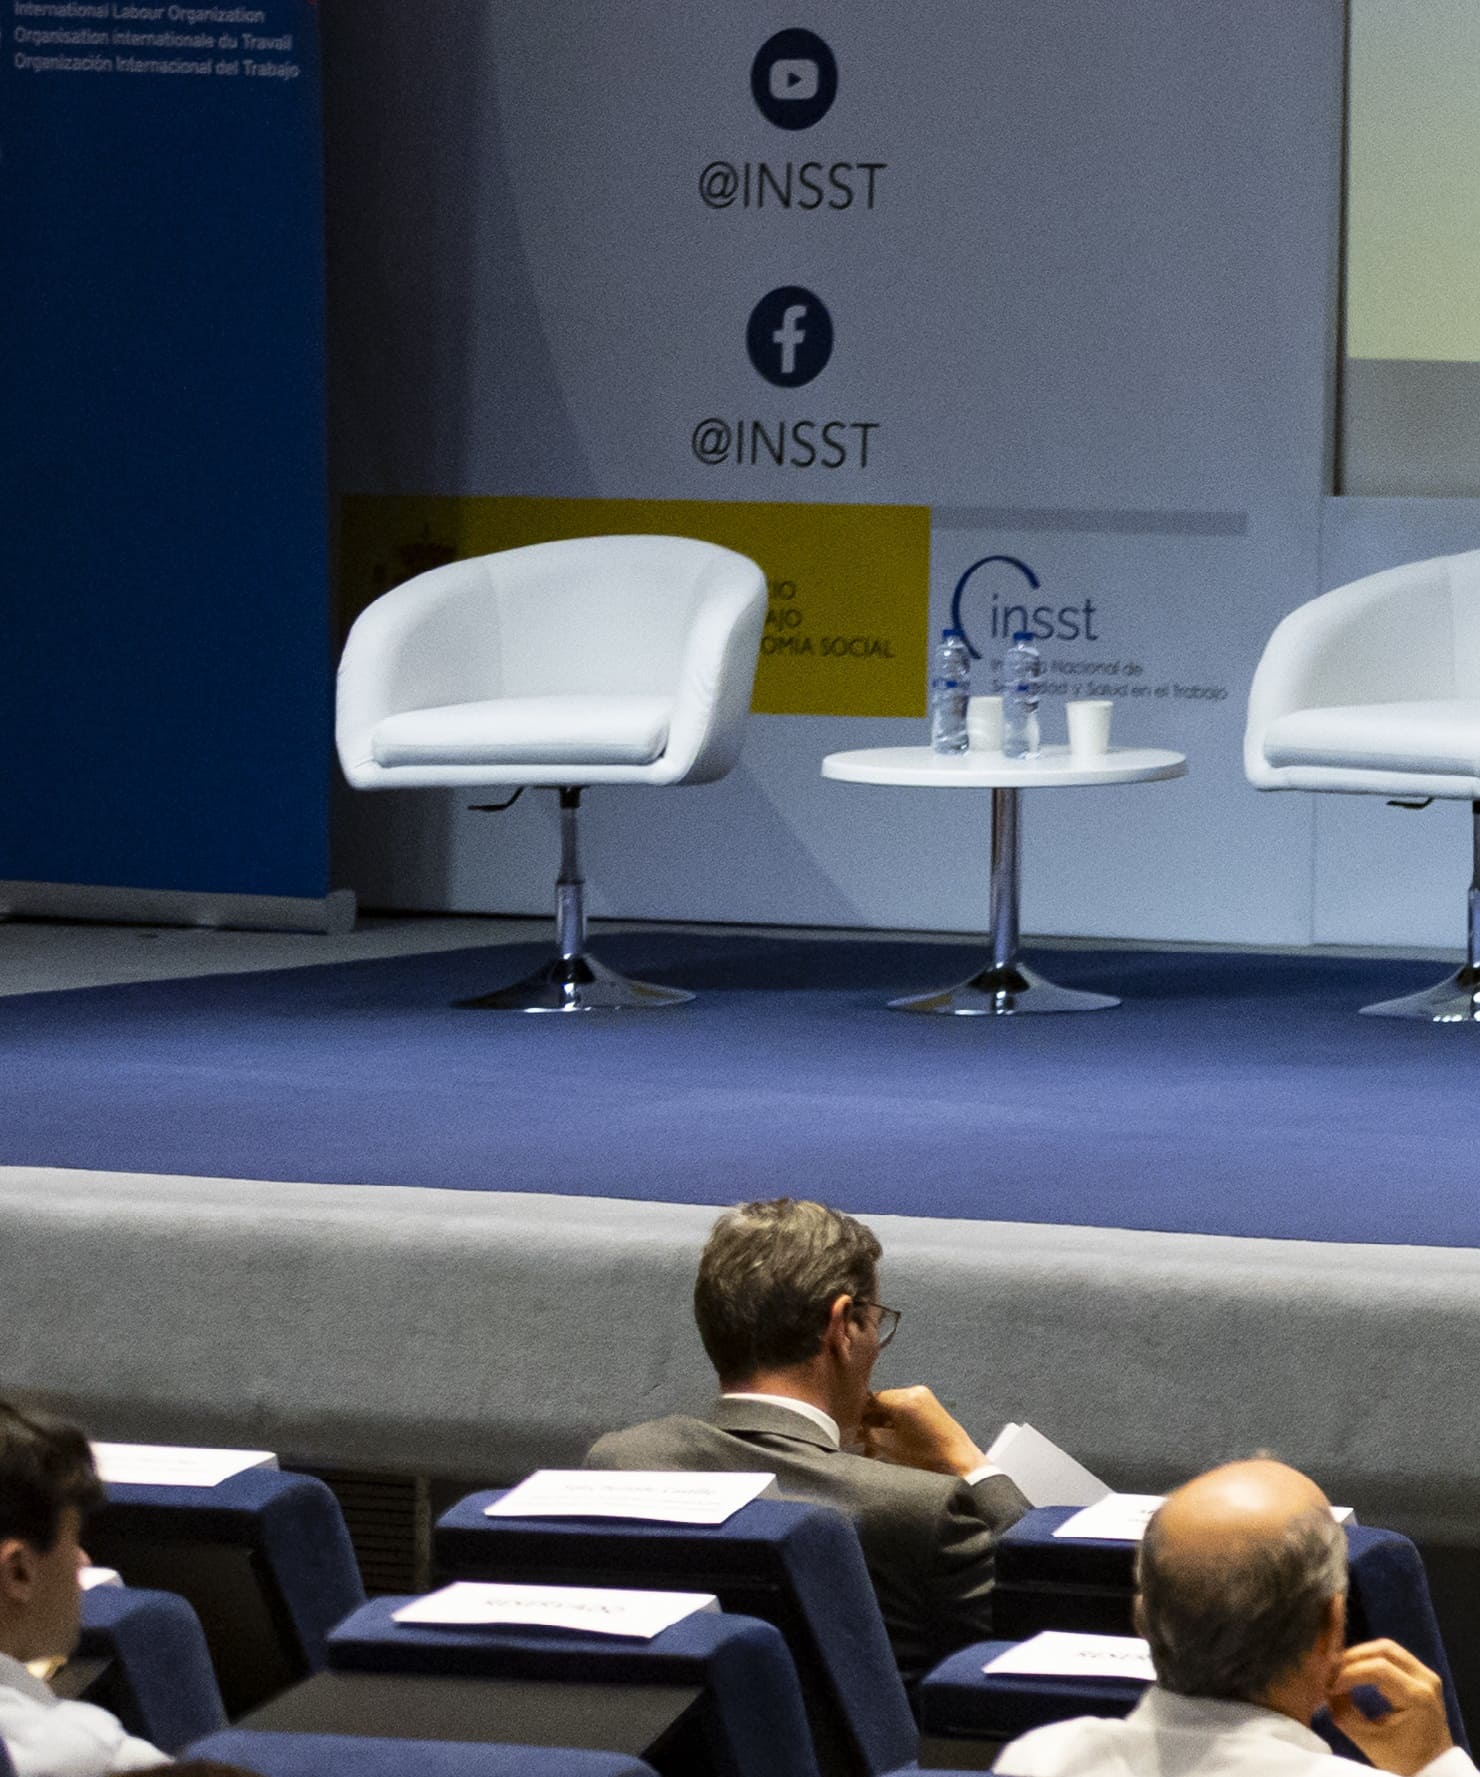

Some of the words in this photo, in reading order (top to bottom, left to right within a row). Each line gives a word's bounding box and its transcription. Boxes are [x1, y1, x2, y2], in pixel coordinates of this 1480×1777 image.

[14, 0, 110, 18] International
[111, 3, 164, 20] Labour
[167, 5, 265, 24] Organization
[14, 26, 110, 45] Organisation
[218, 32, 238, 48] du
[242, 33, 293, 51] Travail
[14, 52, 113, 72] Organización
[116, 55, 213, 74] Internacional
[215, 58, 239, 75] del
[242, 60, 300, 80] Trabajo
[698, 160, 889, 209] @INSST
[691, 417, 881, 469] @INSST
[991, 593, 1100, 641] insst
